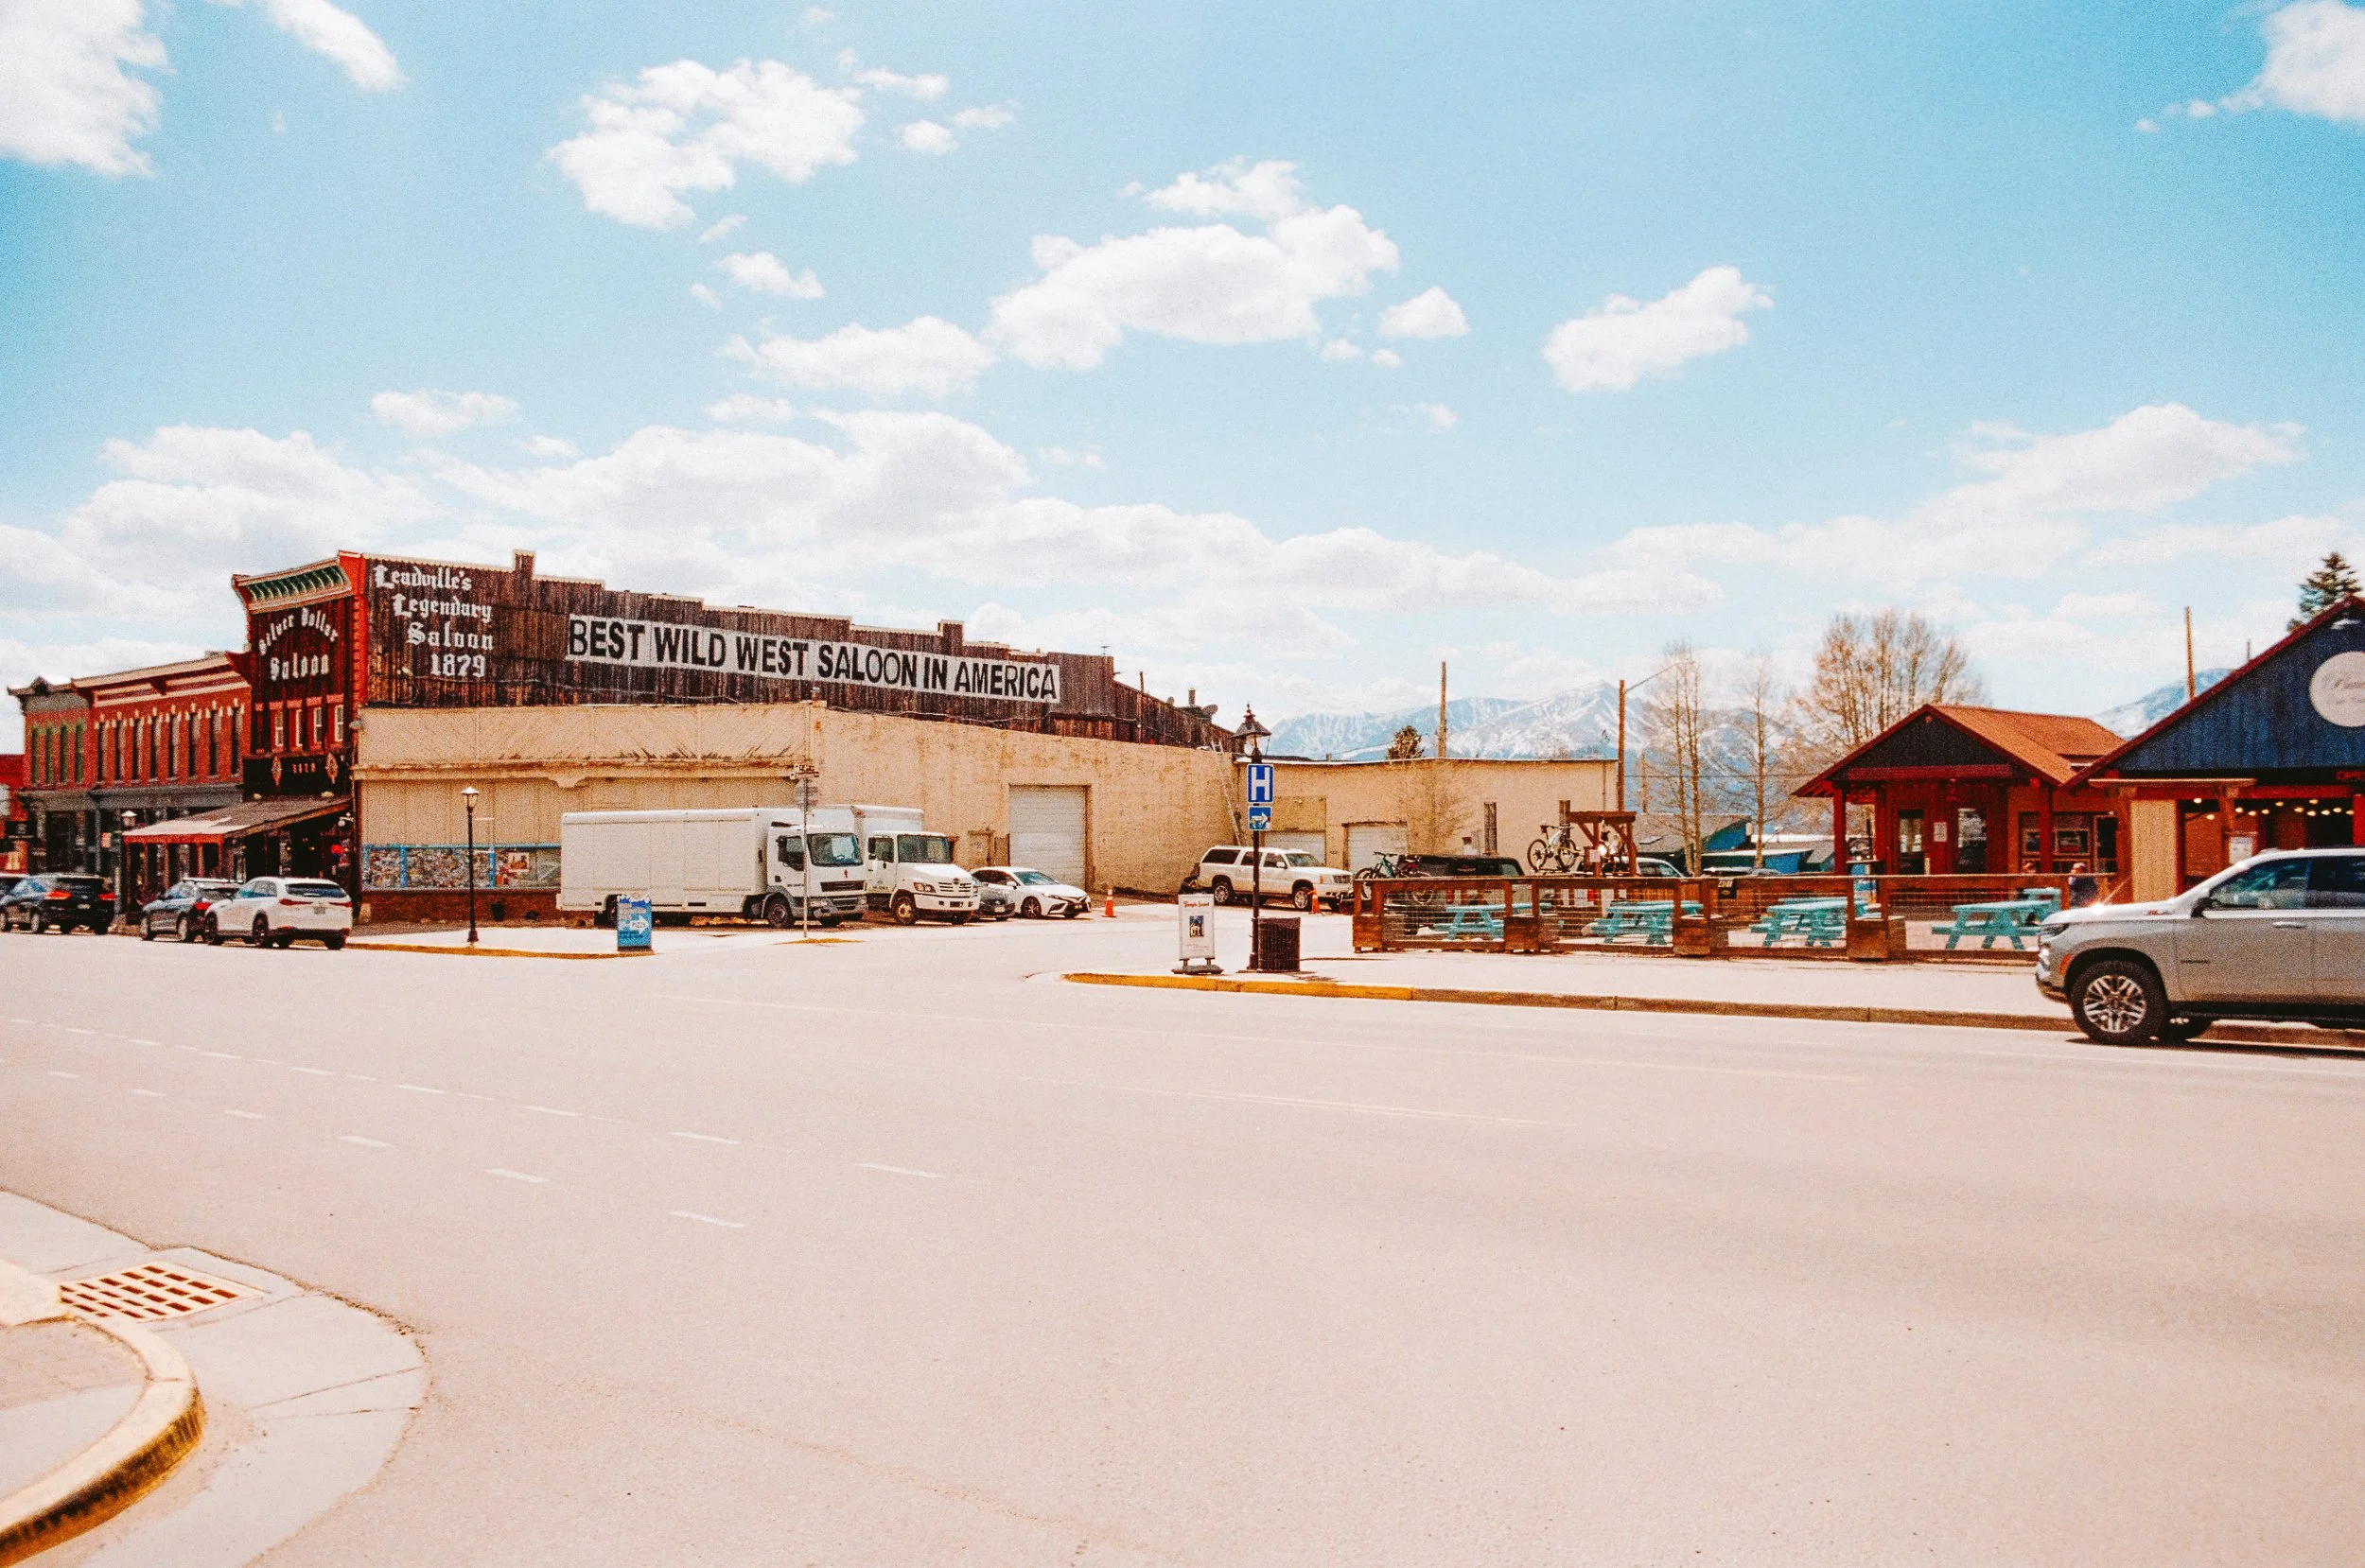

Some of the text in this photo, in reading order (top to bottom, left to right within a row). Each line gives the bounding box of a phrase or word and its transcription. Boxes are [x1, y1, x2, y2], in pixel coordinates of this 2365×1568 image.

[374, 565, 472, 590] Leadville's
[392, 593, 492, 623] Legendary
[301, 607, 339, 642] Dollar
[406, 621, 493, 650] Saloon
[270, 652, 329, 681] Saloon
[430, 653, 485, 678] 1879
[569, 619, 1058, 699] BEST WILD WEST SALOON IN AMERICA
[1251, 767, 1270, 801] H
